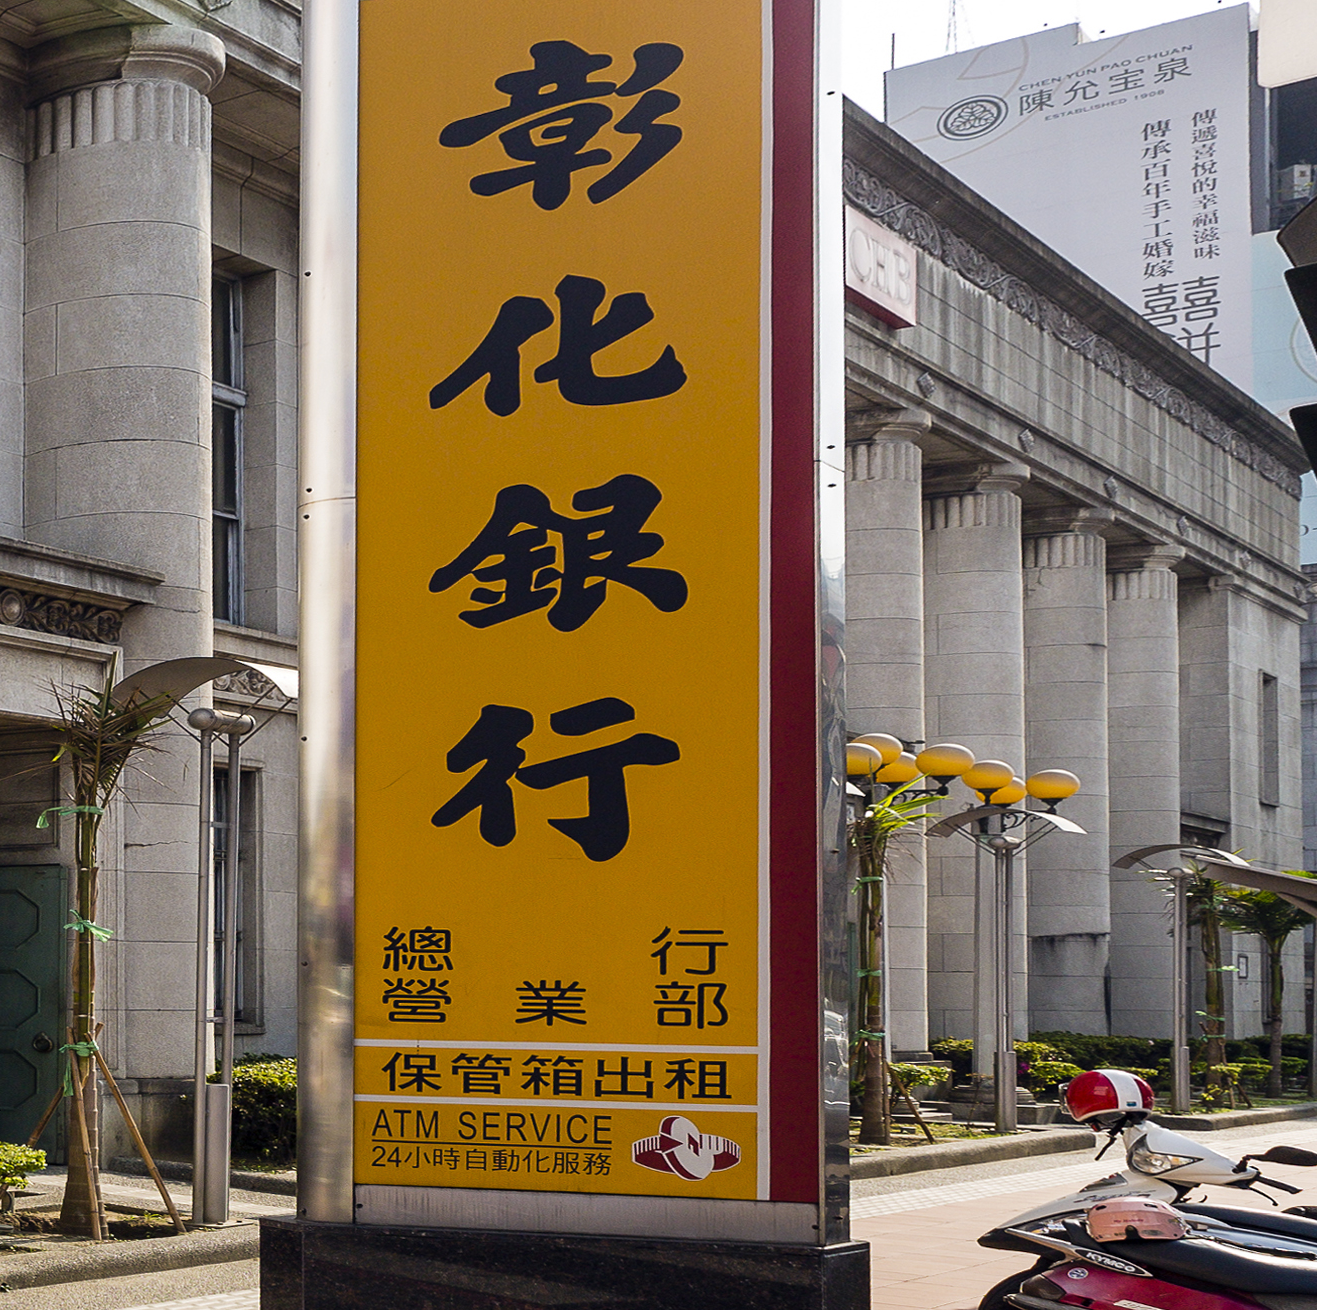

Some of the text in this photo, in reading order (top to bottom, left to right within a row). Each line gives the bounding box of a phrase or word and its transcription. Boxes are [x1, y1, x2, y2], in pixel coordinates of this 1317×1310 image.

[1018, 44, 1193, 92] CHEN YUN PAO CHUAN
[1018, 56, 1193, 116] 陳允宝泉
[1044, 97, 1128, 121] ESTABLISHED
[1141, 118, 1174, 281] 傳承百年手工婚嫁
[848, 225, 911, 306] CHB
[428, 39, 690, 862] 彰化銀行
[381, 1051, 733, 1100] 保管箱出租
[372, 1109, 613, 1145] ATM SERVICE
[371, 1145, 613, 1177] 24小時自動化服務
[1085, 1251, 1136, 1273] KYMCO
